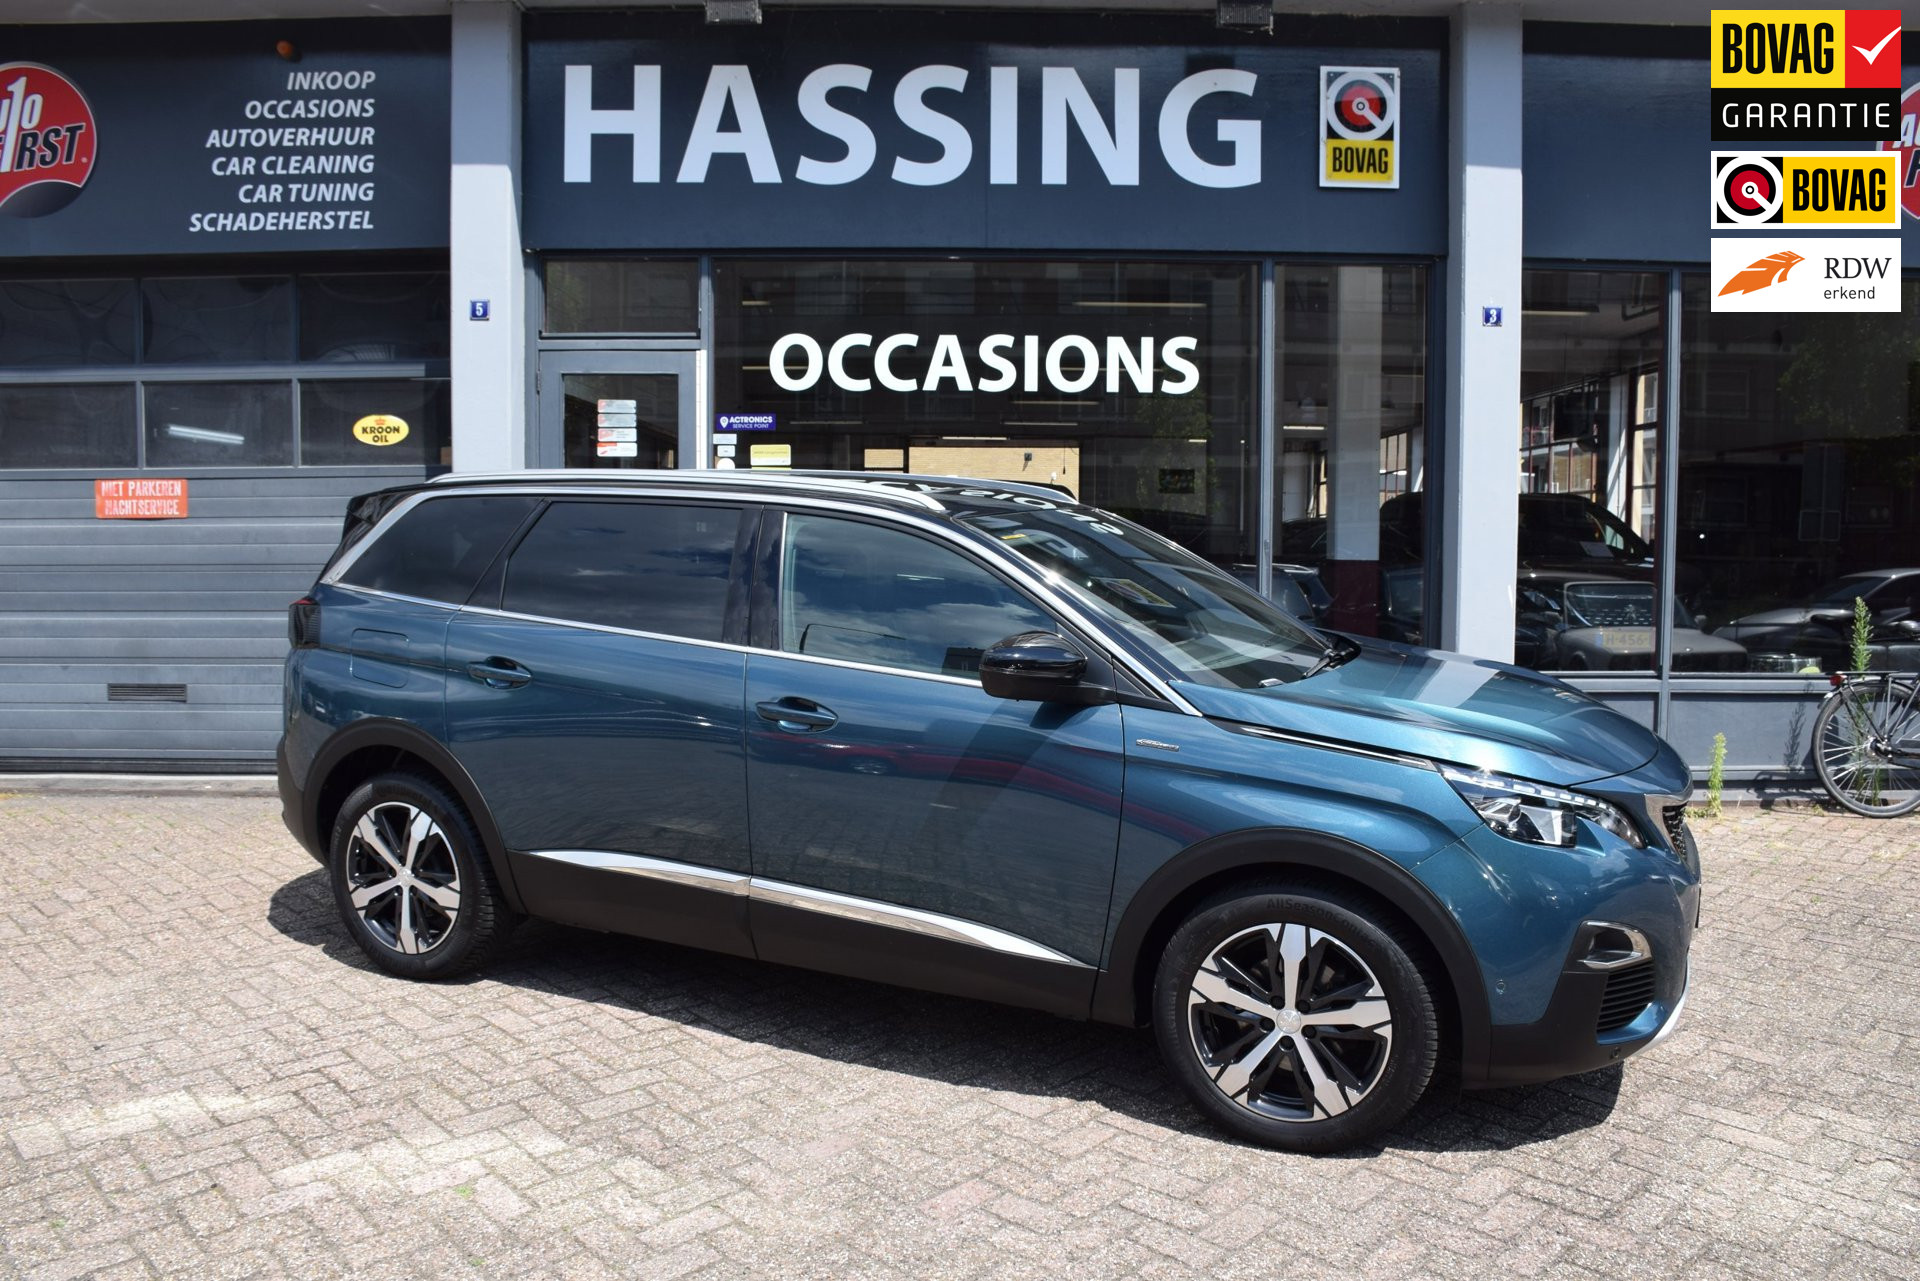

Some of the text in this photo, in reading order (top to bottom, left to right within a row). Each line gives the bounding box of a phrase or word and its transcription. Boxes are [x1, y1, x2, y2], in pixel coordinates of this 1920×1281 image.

[287, 70, 376, 91] INKOOP
[245, 98, 375, 119] OCCASIONS
[563, 63, 1263, 189] HASSING
[205, 126, 376, 148] AUTOVERHUUR
[211, 154, 375, 176] CAR CLEANING
[1332, 146, 1389, 175] BOVAG
[238, 182, 375, 204] CAR TUNING
[189, 210, 374, 232] SCHADEHERSTEL
[475, 302, 484, 317] 5
[1490, 308, 1497, 324] 3
[768, 332, 1201, 396] OCCASIONS
[361, 425, 401, 435] KROON
[372, 434, 389, 443] OIL
[101, 480, 182, 497] NIET PARKEREN
[104, 499, 180, 516] NACHTSERVICE
